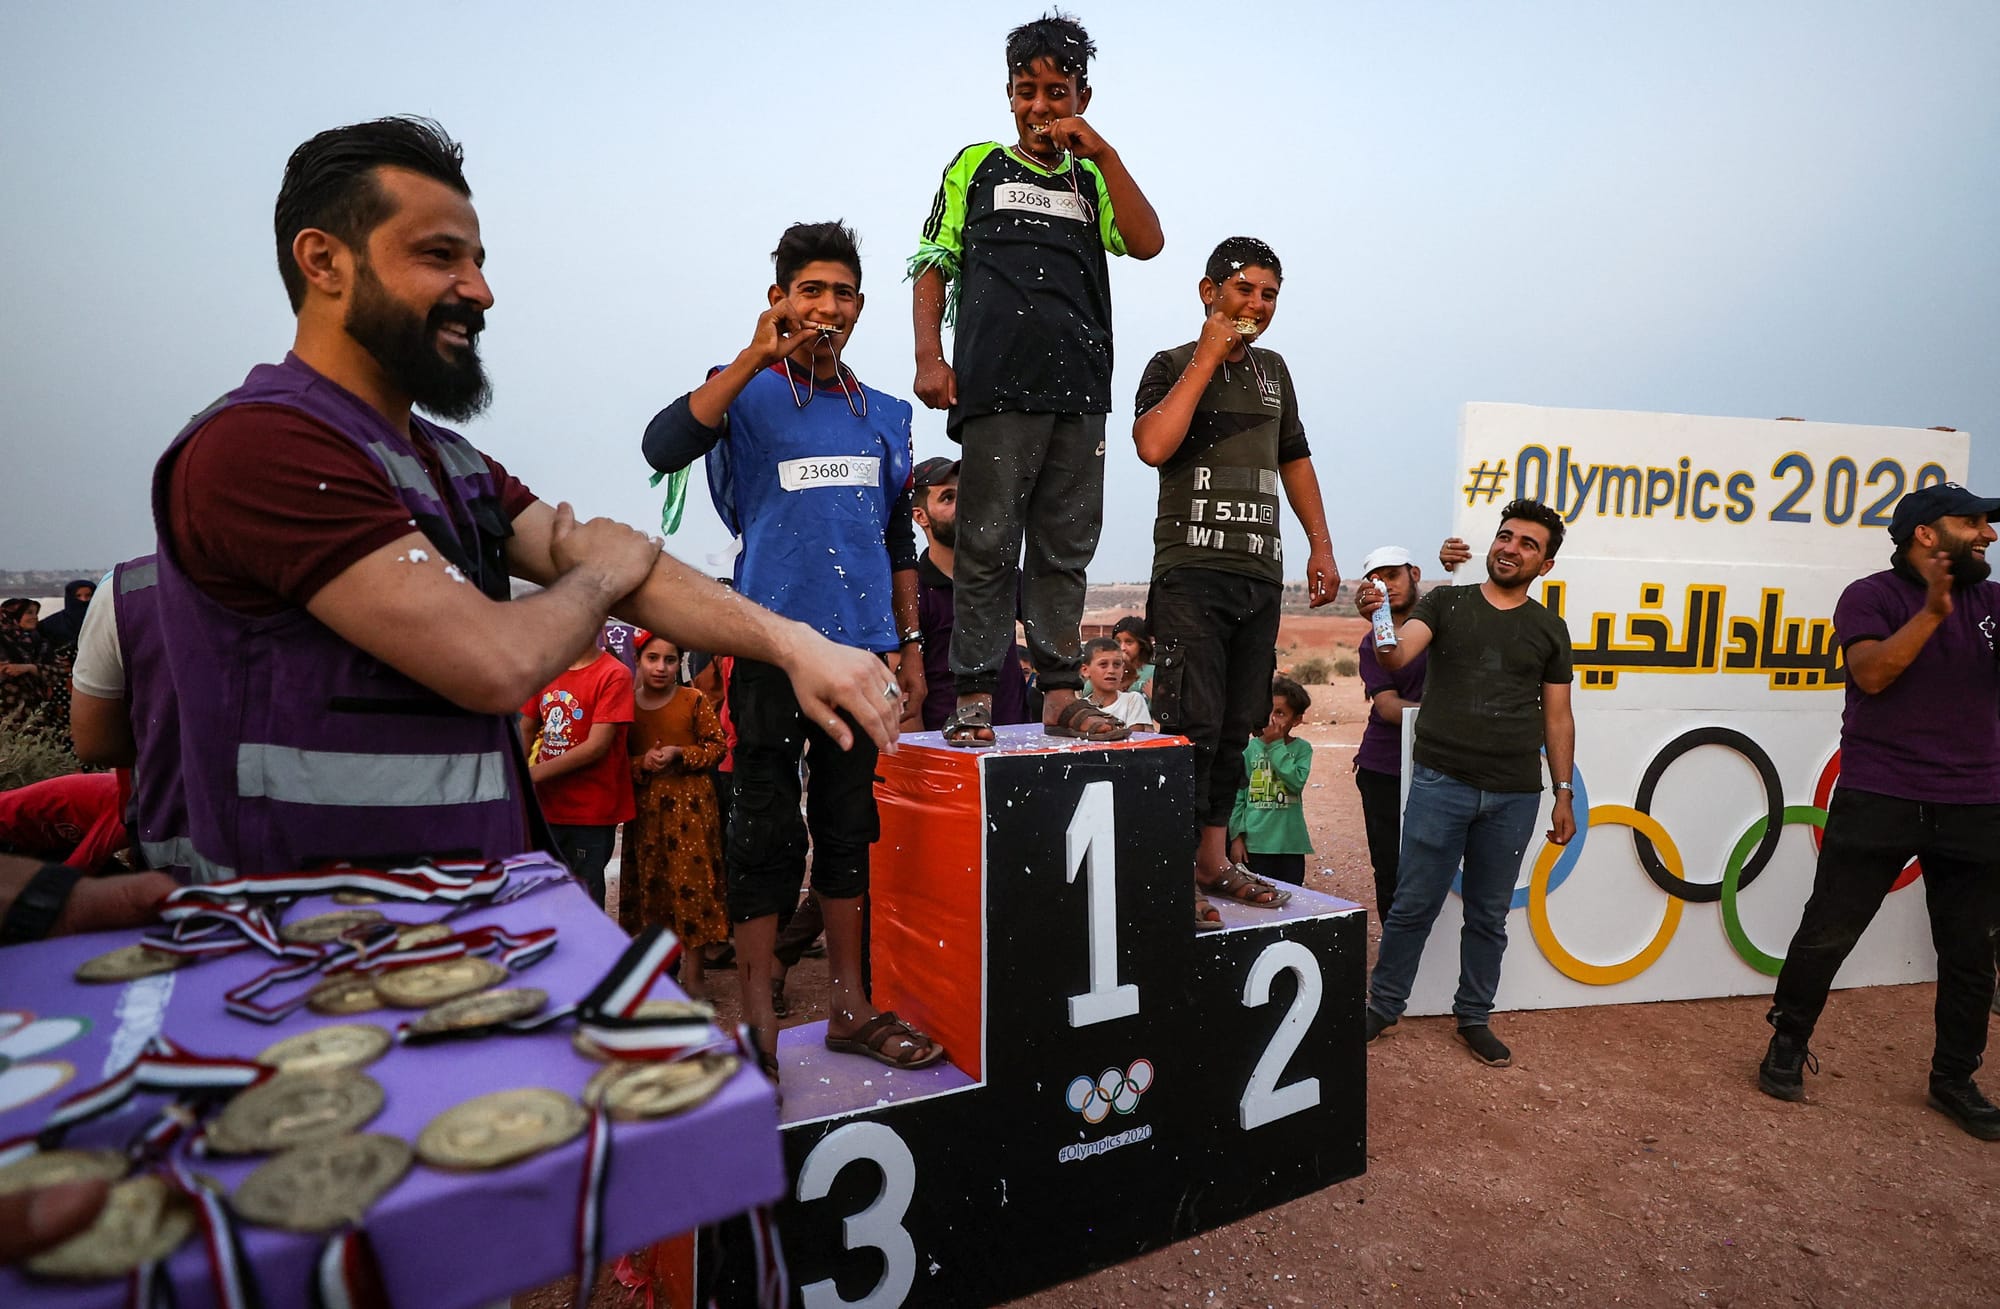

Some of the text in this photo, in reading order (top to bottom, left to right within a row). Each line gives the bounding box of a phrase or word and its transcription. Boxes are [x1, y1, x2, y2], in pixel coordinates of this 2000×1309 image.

[1008, 190, 1051, 209] 32658
[799, 463, 849, 480] 23680
[1215, 501, 1259, 522] 5.11
[1463, 444, 1755, 525] #Olympics
[1541, 579, 1727, 691] الخيا
[1065, 781, 1140, 1027] 1
[1240, 940, 1323, 1130] 2
[1060, 1126, 1152, 1159] #Olympics 2020
[796, 1121, 916, 1309] 3
